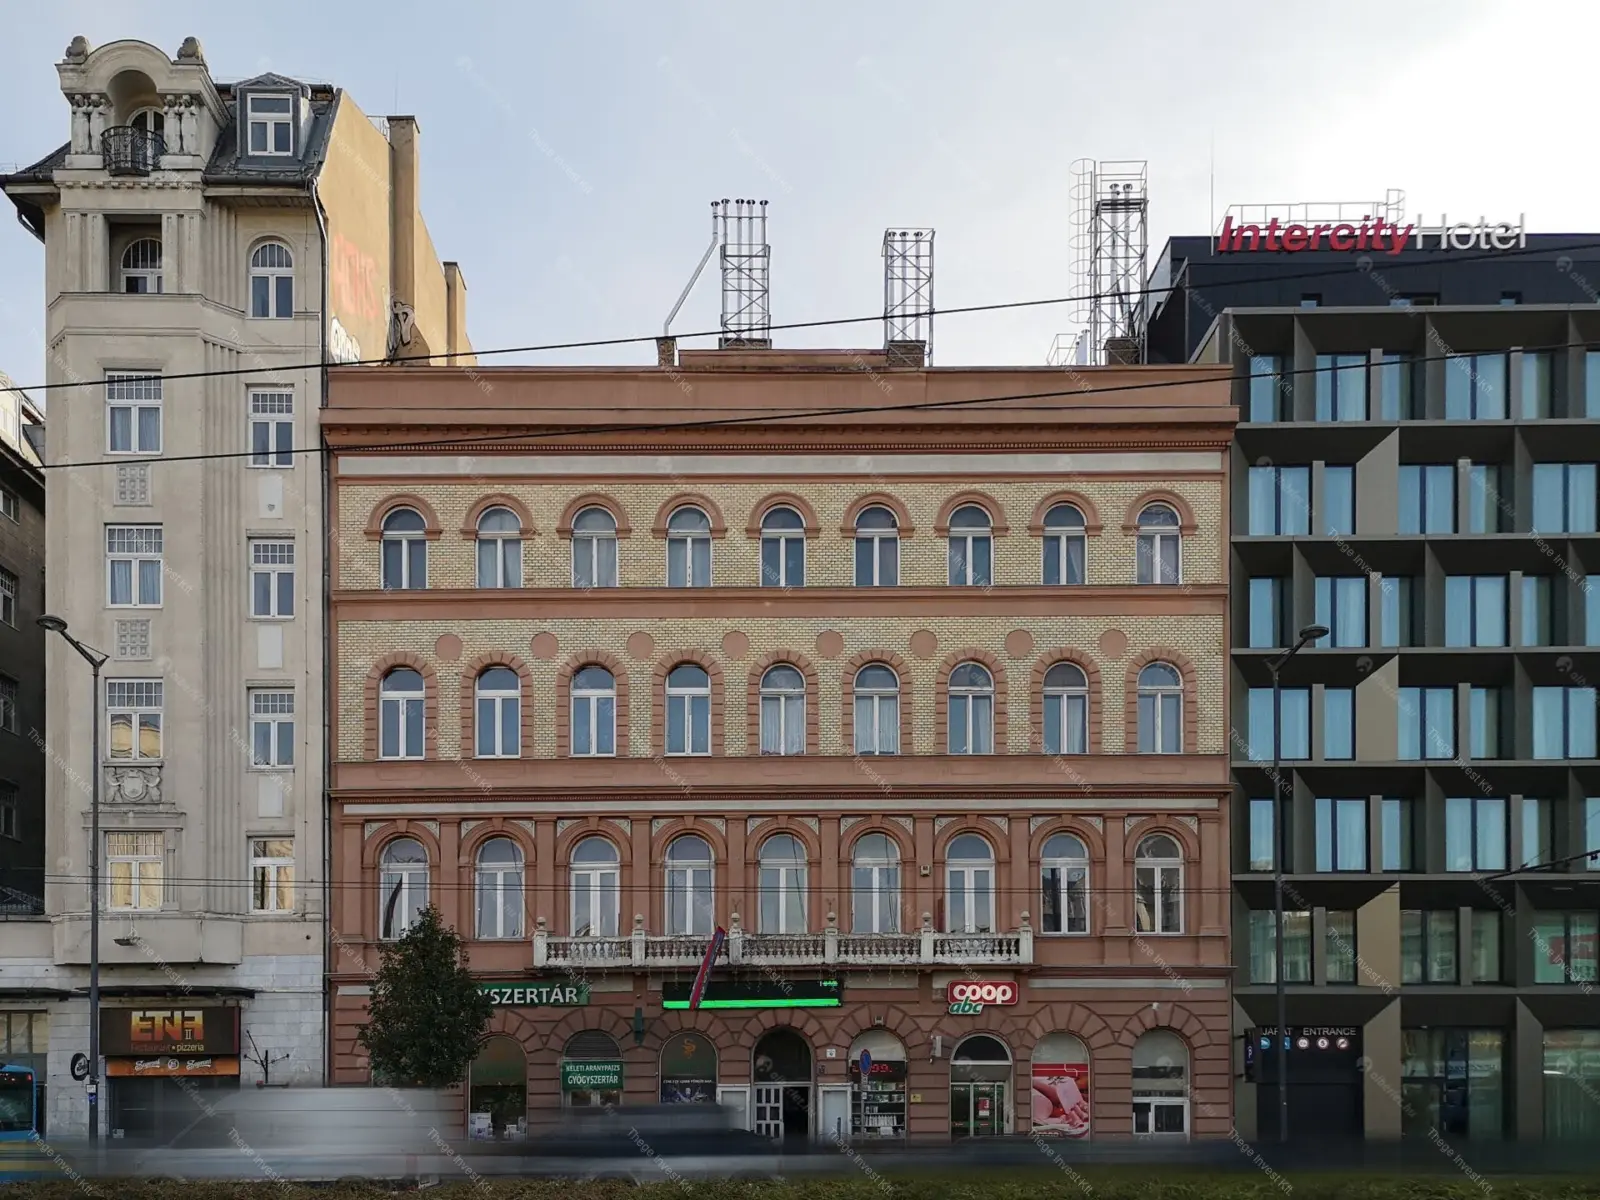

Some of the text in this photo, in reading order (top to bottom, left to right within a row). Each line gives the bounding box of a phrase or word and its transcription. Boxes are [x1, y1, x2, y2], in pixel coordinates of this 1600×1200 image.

[953, 984, 1012, 1004] coop
[949, 997, 982, 1014] abc
[131, 1010, 204, 1041] ETNA
[1302, 1027, 1356, 1036] ENTRANCE
[176, 1043, 204, 1052] pizzeria
[568, 1073, 618, 1084] GYÓGYSZERTÁR
